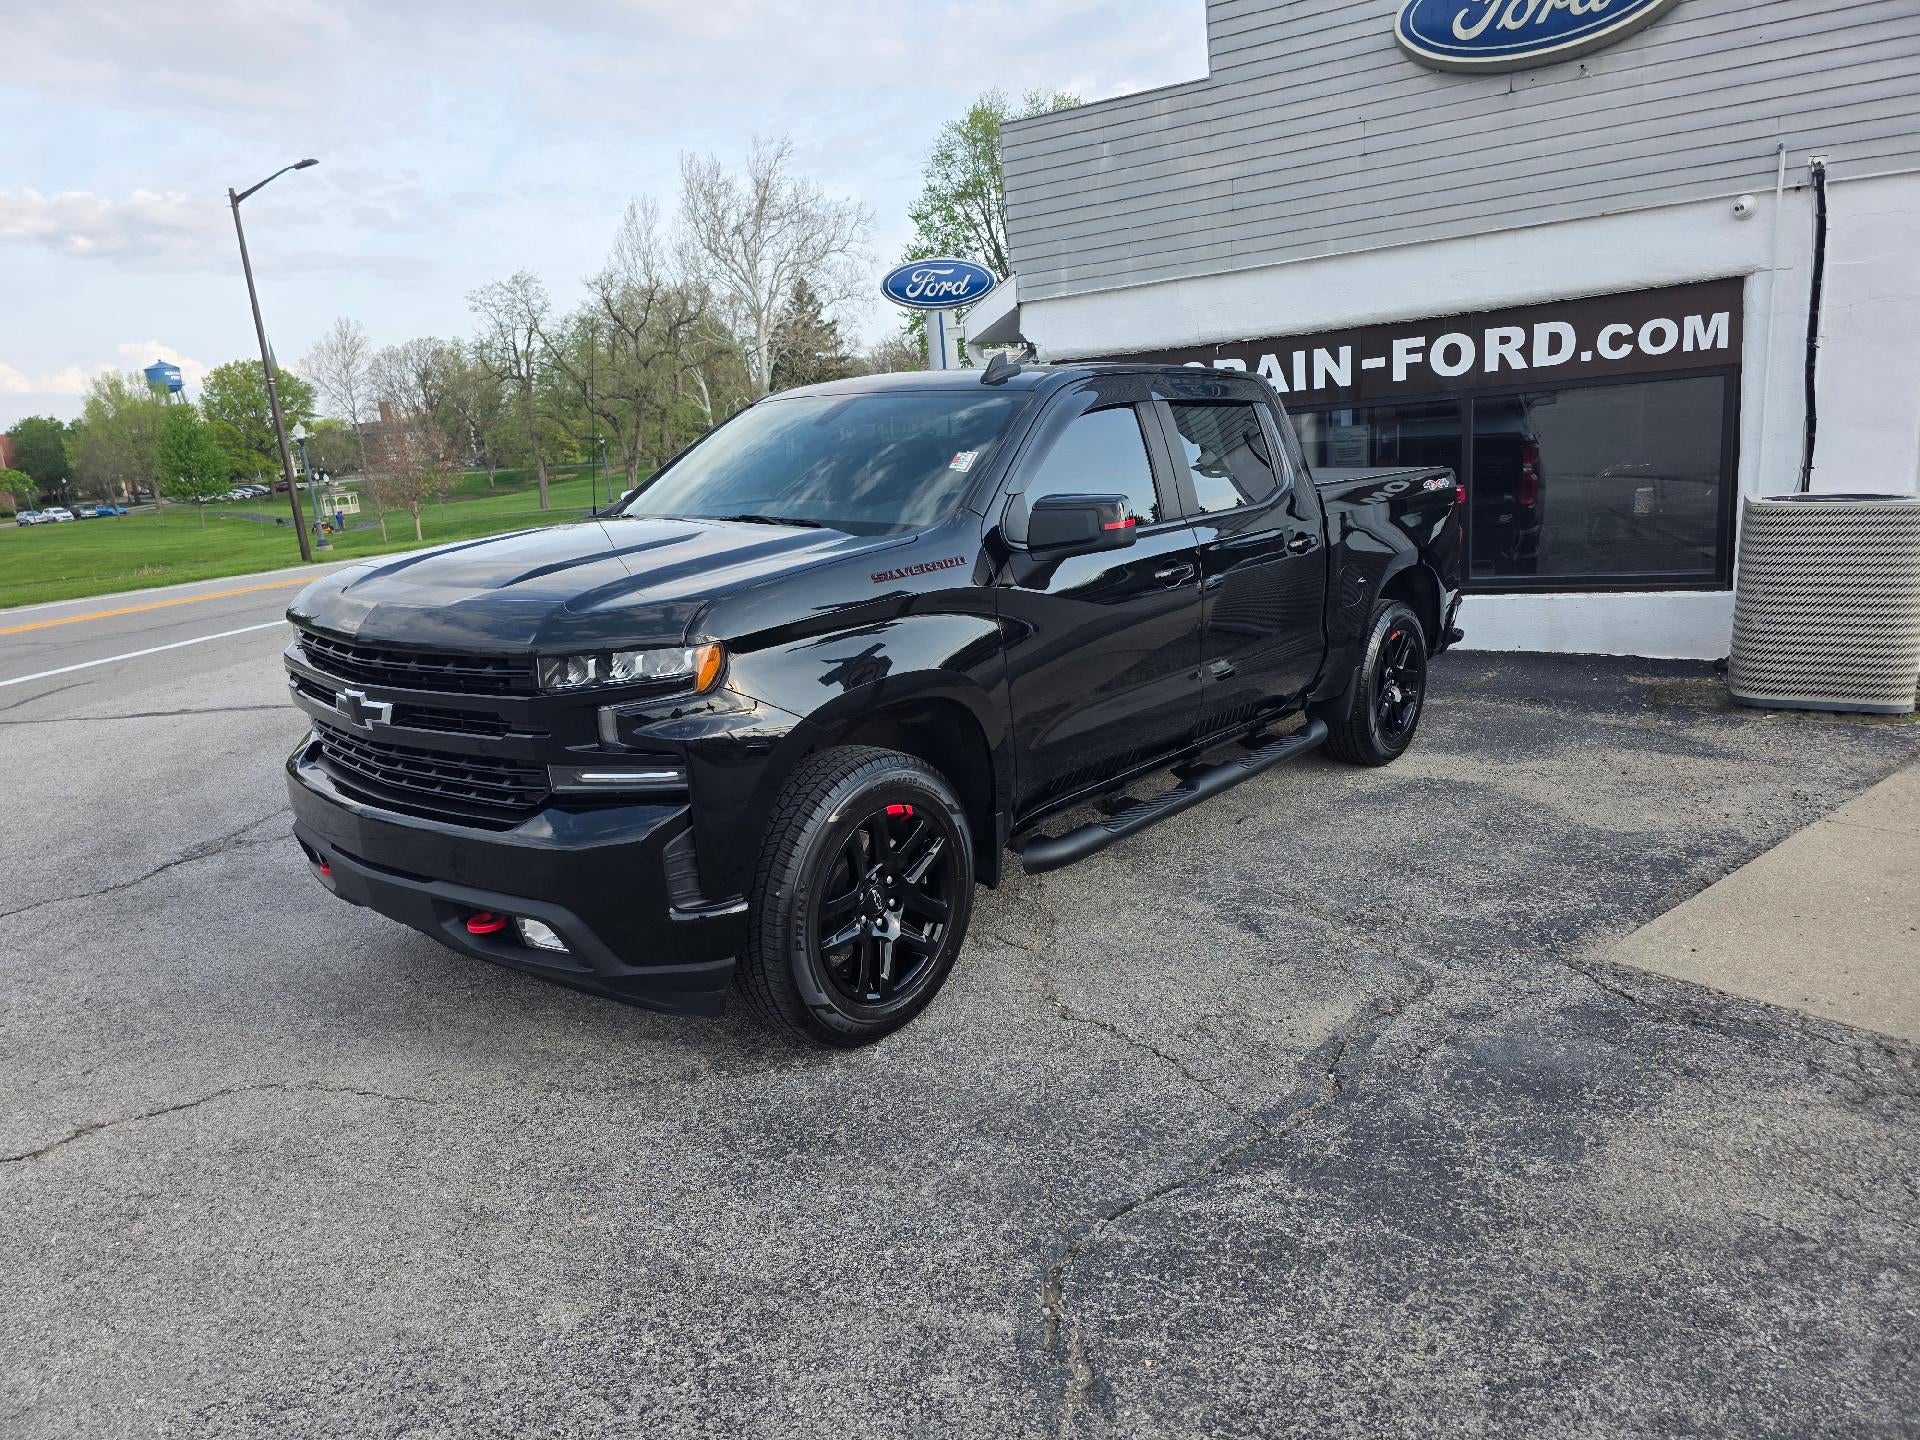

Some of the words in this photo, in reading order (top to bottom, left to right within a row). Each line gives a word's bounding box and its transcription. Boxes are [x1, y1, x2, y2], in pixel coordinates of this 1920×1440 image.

[905, 268, 971, 298] Ford
[1182, 311, 1730, 393] AIN-FORD.COM
[870, 555, 968, 584] SILVERADO
